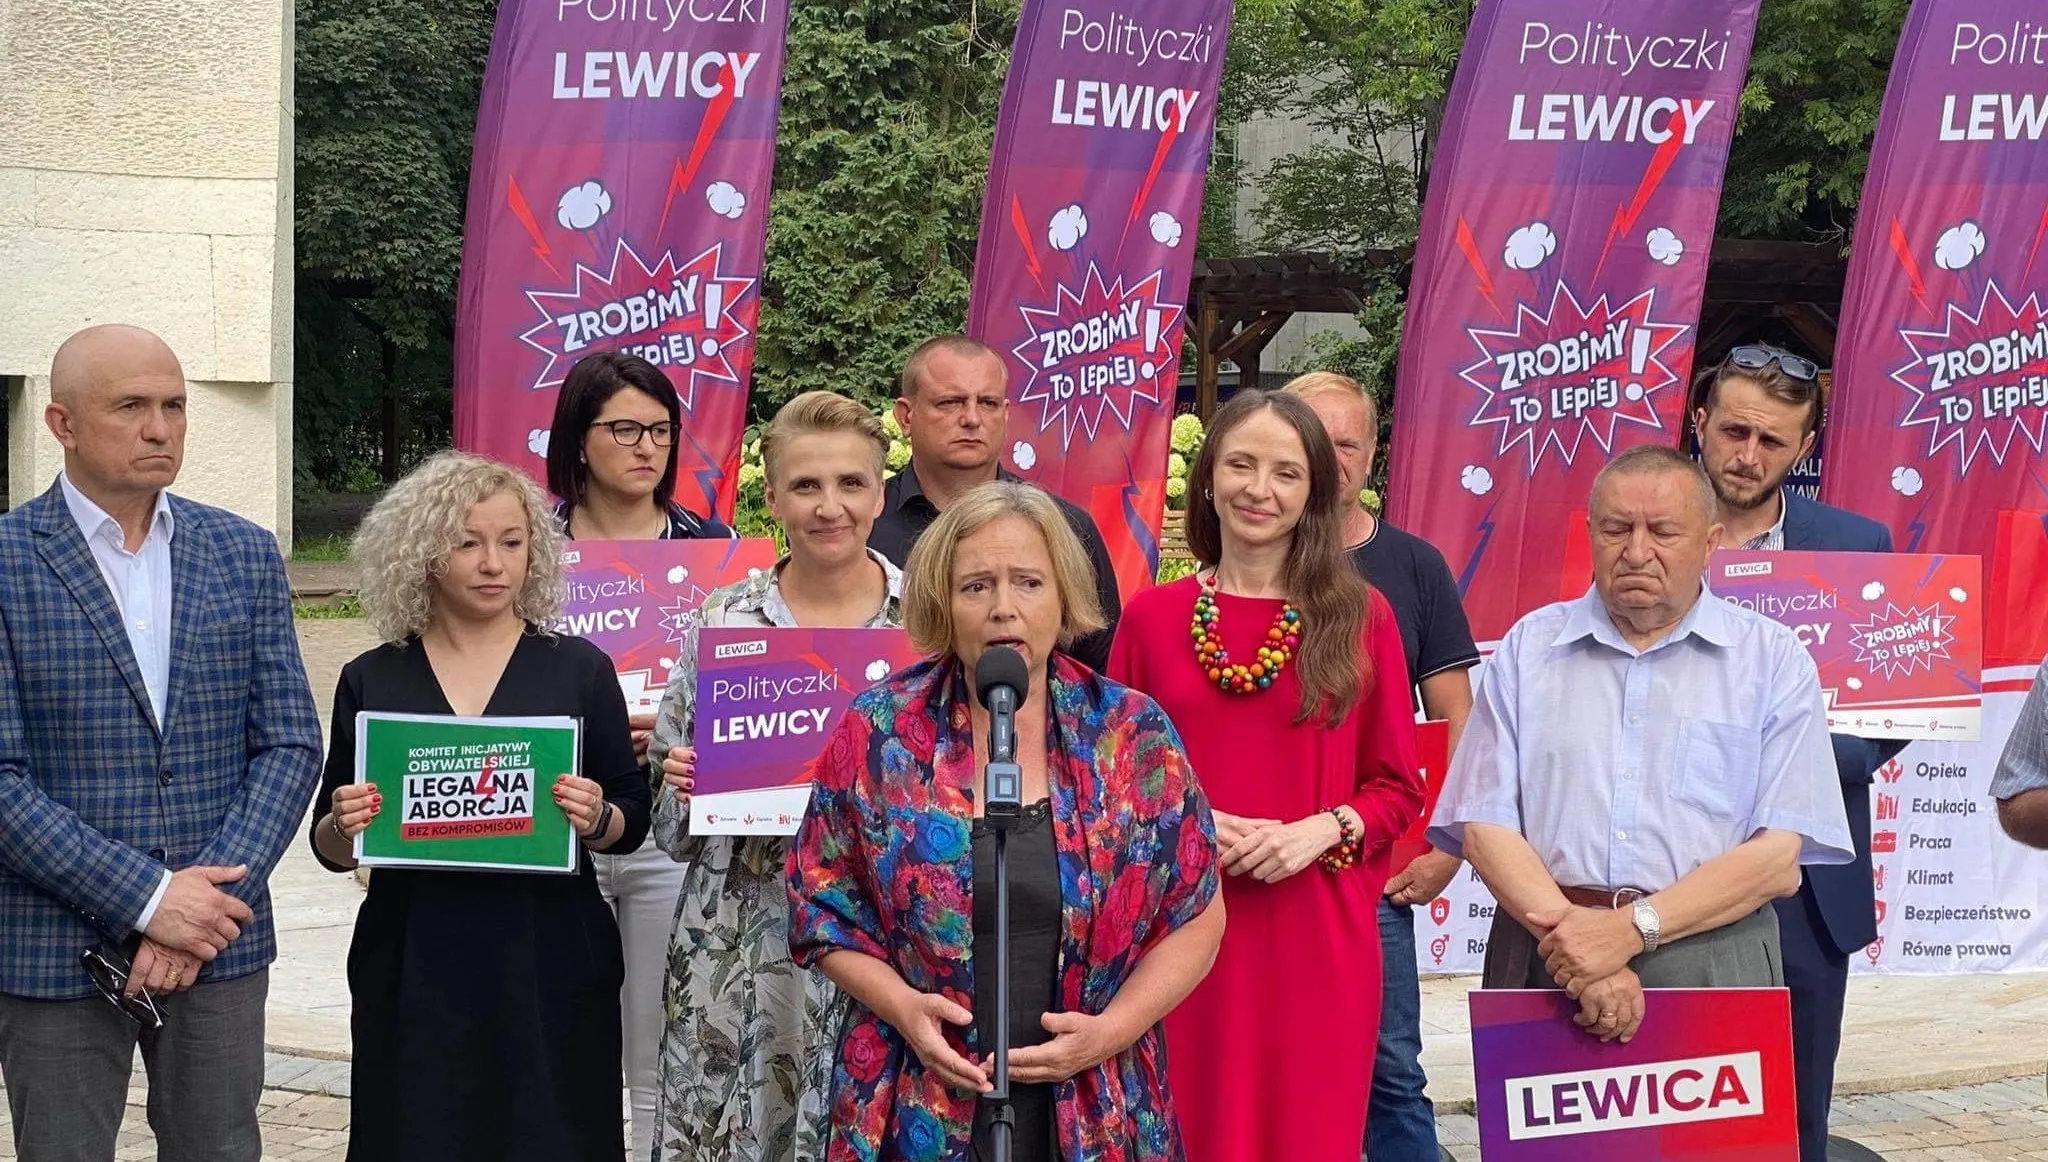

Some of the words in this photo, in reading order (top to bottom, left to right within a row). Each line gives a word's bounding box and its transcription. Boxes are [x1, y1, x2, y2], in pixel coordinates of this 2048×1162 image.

[1059, 8, 1213, 67] Polityczki
[1518, 21, 1733, 77] Polityczki
[552, 51, 762, 100] LEWICY
[1051, 78, 1200, 134] LEWICY
[1507, 93, 1716, 145] LEWICY
[1050, 373, 1075, 401] TO
[1510, 396, 1542, 424] TO
[1940, 395, 1973, 425] TO
[1728, 563, 1770, 575] LEWICA
[567, 573, 645, 604] lityczki
[553, 606, 641, 636] EWICY
[718, 642, 764, 656] LEWICA
[713, 667, 839, 704] Polityczki
[712, 706, 833, 744] LEWICY
[408, 746, 457, 758] KOMITET
[461, 741, 531, 756] INICJATYWY
[408, 754, 531, 773] OBYWATELSKIEJ
[1915, 762, 1968, 781] Opieka
[408, 796, 527, 820] ABORCJA
[1911, 797, 1977, 817] Edukacja
[408, 826, 429, 837] BEZ
[432, 818, 526, 836] KOMPROMISÓW
[1909, 833, 1952, 850] Praca
[1907, 869, 1954, 886] Klimat
[1904, 905, 2031, 925] Bezpieczeństwo
[1902, 940, 1952, 957] Równe
[1956, 943, 2012, 959] prawa
[1521, 1063, 1751, 1128] LEWICA
